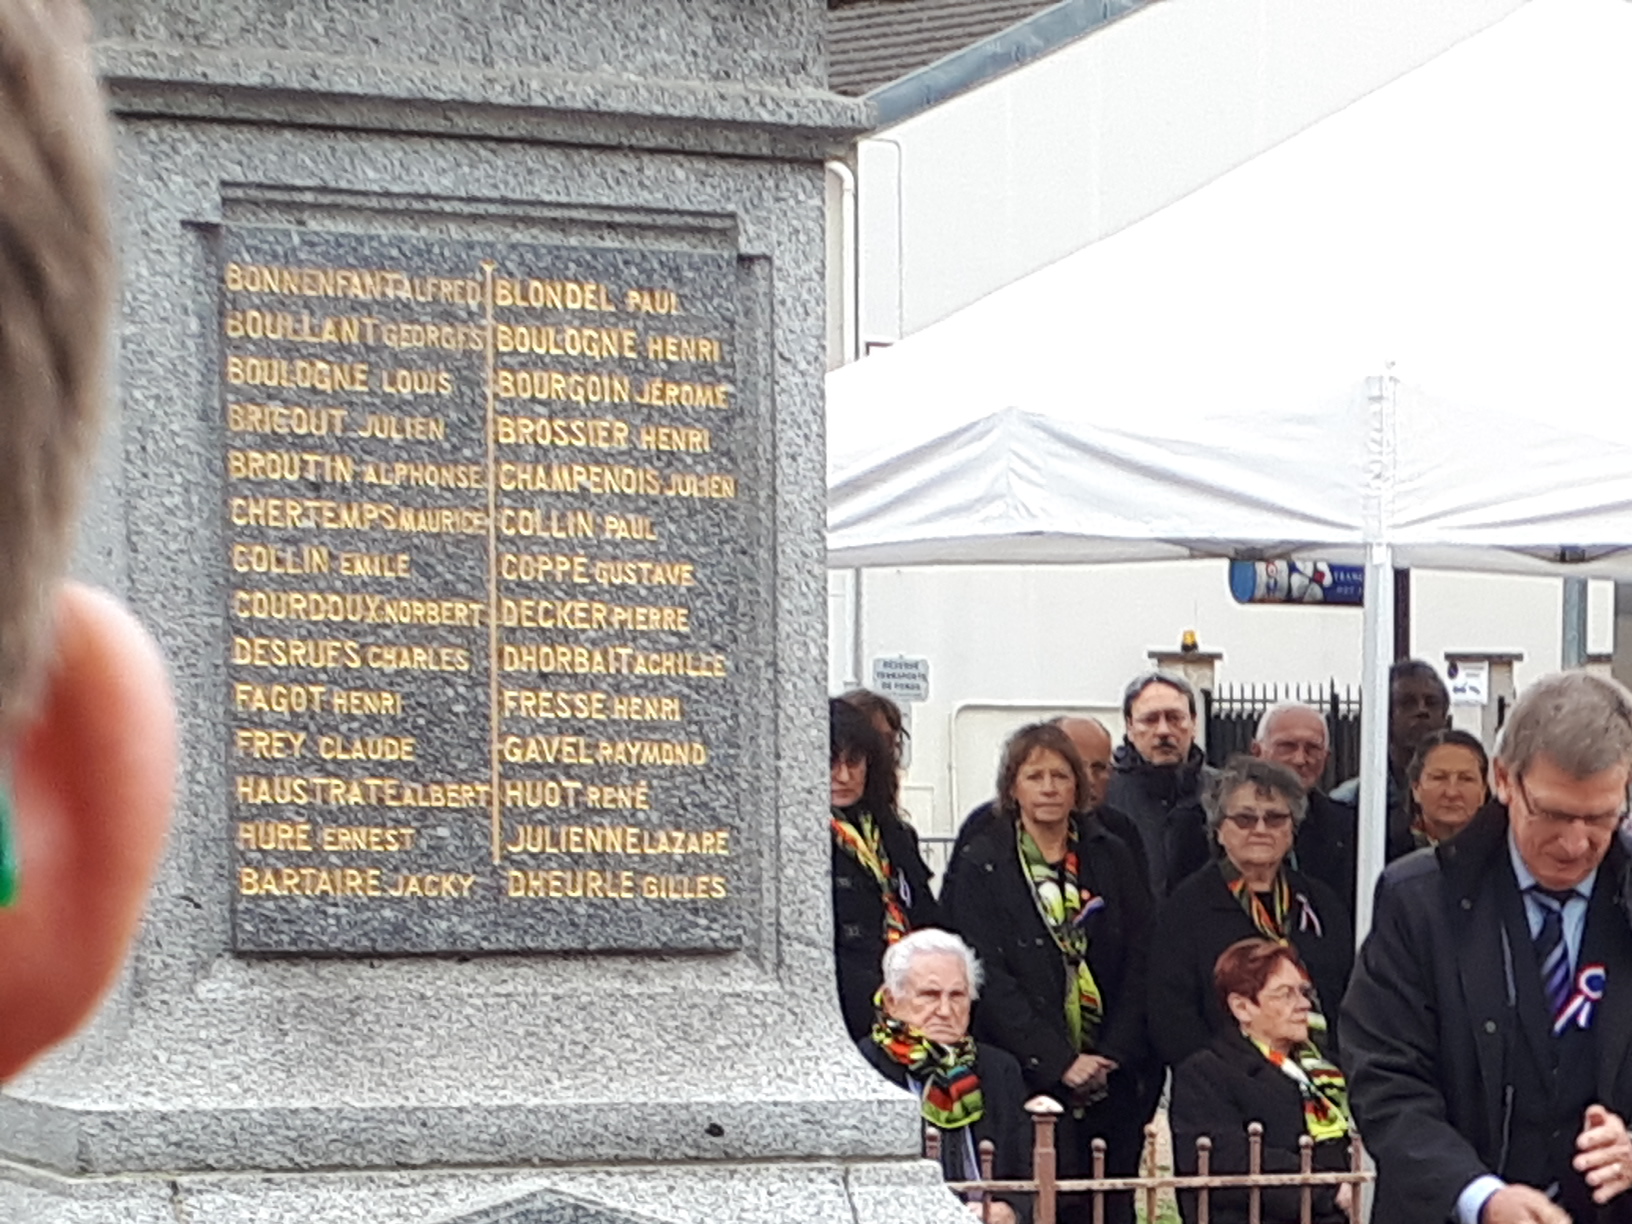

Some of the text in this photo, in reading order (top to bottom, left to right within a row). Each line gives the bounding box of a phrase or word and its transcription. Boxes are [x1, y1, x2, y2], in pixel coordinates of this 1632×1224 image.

[225, 263, 481, 303] BONNENFANT ALFRED
[494, 278, 684, 315] BLONDEL PAUL
[383, 325, 484, 351] GEORGES
[496, 323, 721, 362] BOULOGNE HENRI
[227, 356, 452, 395] BOULOGNE LOUIS
[496, 370, 630, 405] BOURGOIN
[358, 415, 444, 440] JULIEN
[497, 416, 710, 452] BROSSIER HENRI
[227, 450, 484, 489] BROUTIN ALPHONSE
[498, 462, 737, 498] CHAMPENOIS JULIEN
[231, 498, 487, 535] CHERTEMPS MAURICE
[501, 507, 657, 540] COLLIN PAUL
[232, 543, 330, 573] COLLIN
[595, 561, 695, 587] GUSTAVE
[233, 590, 484, 627] COURDOUX NORBERT
[501, 597, 690, 631] DECKER PIERRE
[233, 637, 470, 671] DESRUES CHARLES
[503, 644, 727, 677] DHORBAIT ACHILLE
[234, 683, 402, 715] FAGOT HENRI
[502, 689, 681, 721] FRESSE HENRI
[234, 730, 415, 761] FREY CLAUDE
[503, 735, 708, 766] GAVEL RAYMOND
[235, 776, 491, 808] HAUSTRATE ALBERT
[505, 779, 582, 808] HUOT
[323, 827, 414, 851] ERNEST
[507, 825, 729, 855] JULIENNE LAZARE
[239, 867, 476, 898] BARTAIRE JACKY
[508, 869, 726, 899] DHEURLE GILLES
